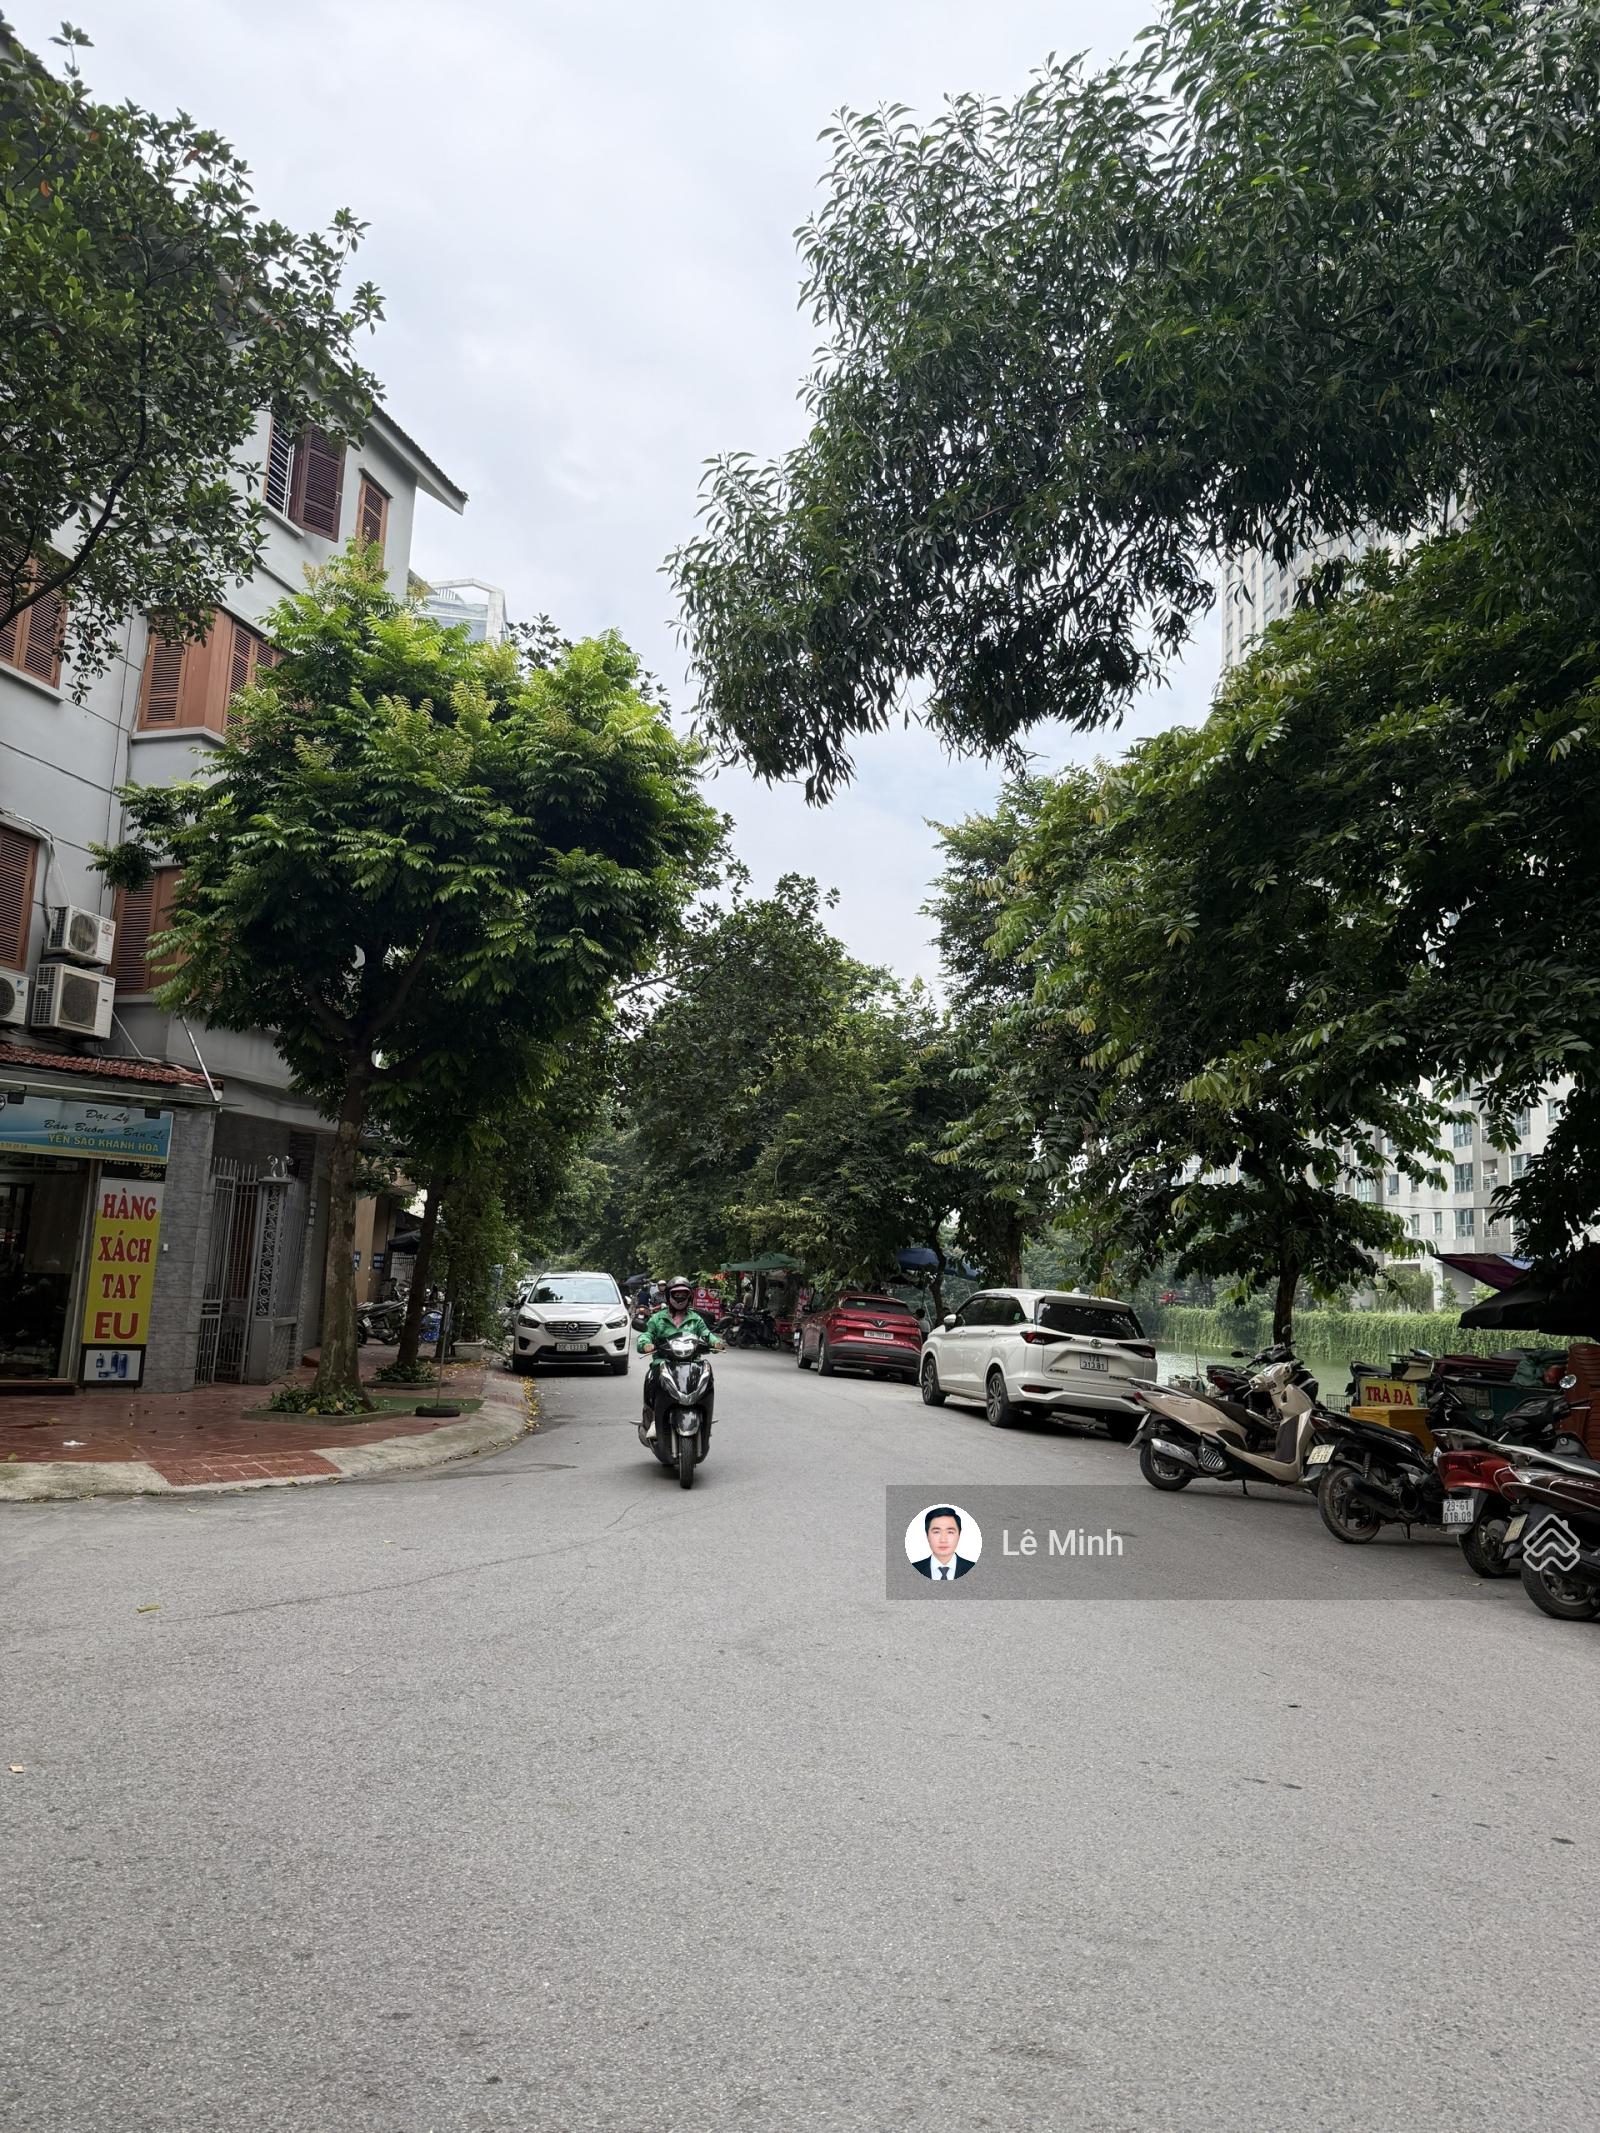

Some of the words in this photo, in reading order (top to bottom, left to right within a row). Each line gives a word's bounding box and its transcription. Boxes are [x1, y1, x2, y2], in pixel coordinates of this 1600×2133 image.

[102, 1187, 157, 1221] HÀNG
[97, 1230, 152, 1263] XÁCH
[102, 1274, 141, 1299] TAY
[94, 1312, 139, 1339] EU
[1365, 1384, 1392, 1403] TRÀ
[1393, 1386, 1414, 1406] ĐÁ
